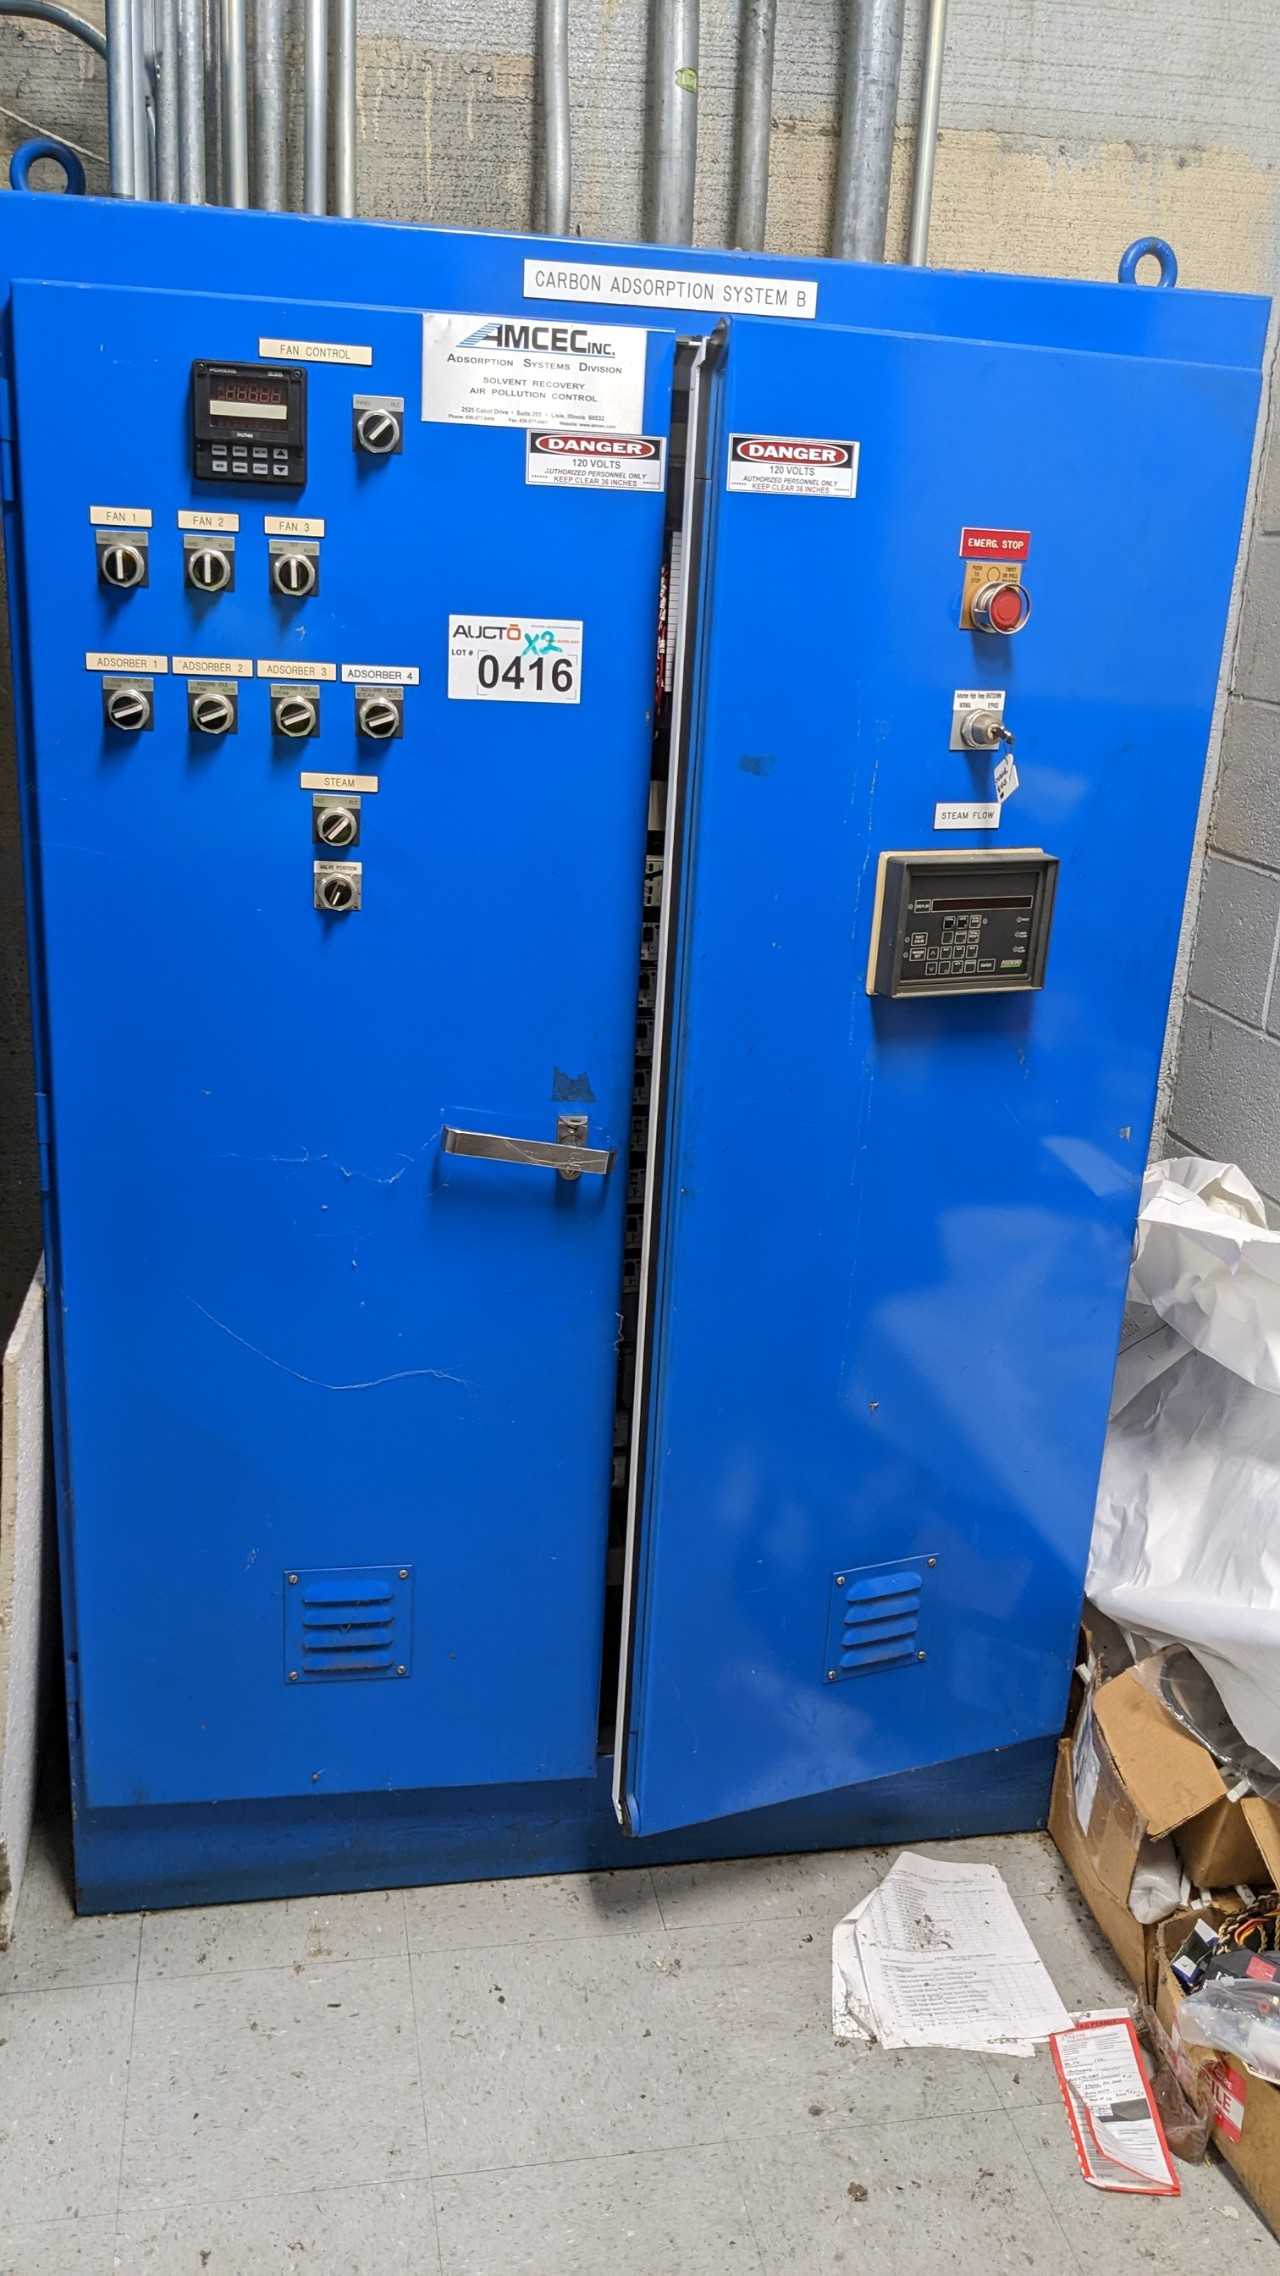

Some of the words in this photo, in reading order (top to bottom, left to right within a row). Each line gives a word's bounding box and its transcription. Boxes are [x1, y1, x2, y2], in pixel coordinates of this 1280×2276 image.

[535, 270, 601, 291] CARBON
[610, 276, 714, 300] ADSORPTION
[723, 285, 788, 306] SYSTEM
[796, 291, 807, 307] B
[457, 322, 588, 353] AMCEC
[587, 342, 616, 356] INC.
[280, 344, 299, 356] FAN
[305, 346, 351, 360] CONTROL
[483, 376, 528, 387] SOLVENT
[532, 380, 585, 391] RECOVERY
[470, 387, 486, 396] AIR
[491, 388, 546, 399] POLLUTION
[552, 392, 598, 403] CONTROL
[548, 438, 643, 455] DANGER
[748, 444, 837, 461] DANGER
[572, 458, 588, 468] 120
[590, 459, 621, 469] VOLTS
[545, 467, 586, 476] AUTHORIZED
[588, 470, 627, 479] PERSONNEL
[770, 465, 784, 474] 120
[786, 466, 815, 476] VOLTS
[554, 476, 573, 484] KEEP
[575, 477, 600, 485] CLEAR
[611, 479, 637, 487] INCHES
[744, 475, 782, 484] AUTHORIZED
[783, 477, 819, 486] PERSONNEL
[772, 484, 795, 492] CLEAR
[805, 486, 830, 494] INCHES
[106, 511, 126, 522] FAN
[132, 513, 136, 523] 1
[193, 515, 212, 527] FAN
[217, 517, 224, 528] 2
[279, 521, 298, 532] FAN
[304, 522, 310, 532] 3
[968, 538, 999, 549] EMERG.
[1002, 540, 1024, 550] STOP
[97, 657, 147, 668] ADSORBER
[153, 660, 158, 668] 1
[182, 663, 231, 673] ADSORBER
[238, 664, 243, 673] 2
[267, 665, 315, 676] ADSORBER
[321, 666, 327, 676] 3
[348, 669, 402, 680] ADSORBER
[406, 672, 413, 680] 4
[478, 654, 573, 692] 0416
[324, 777, 355, 787] STEAM
[942, 812, 969, 820] STEAM
[972, 811, 994, 820] FLOW
